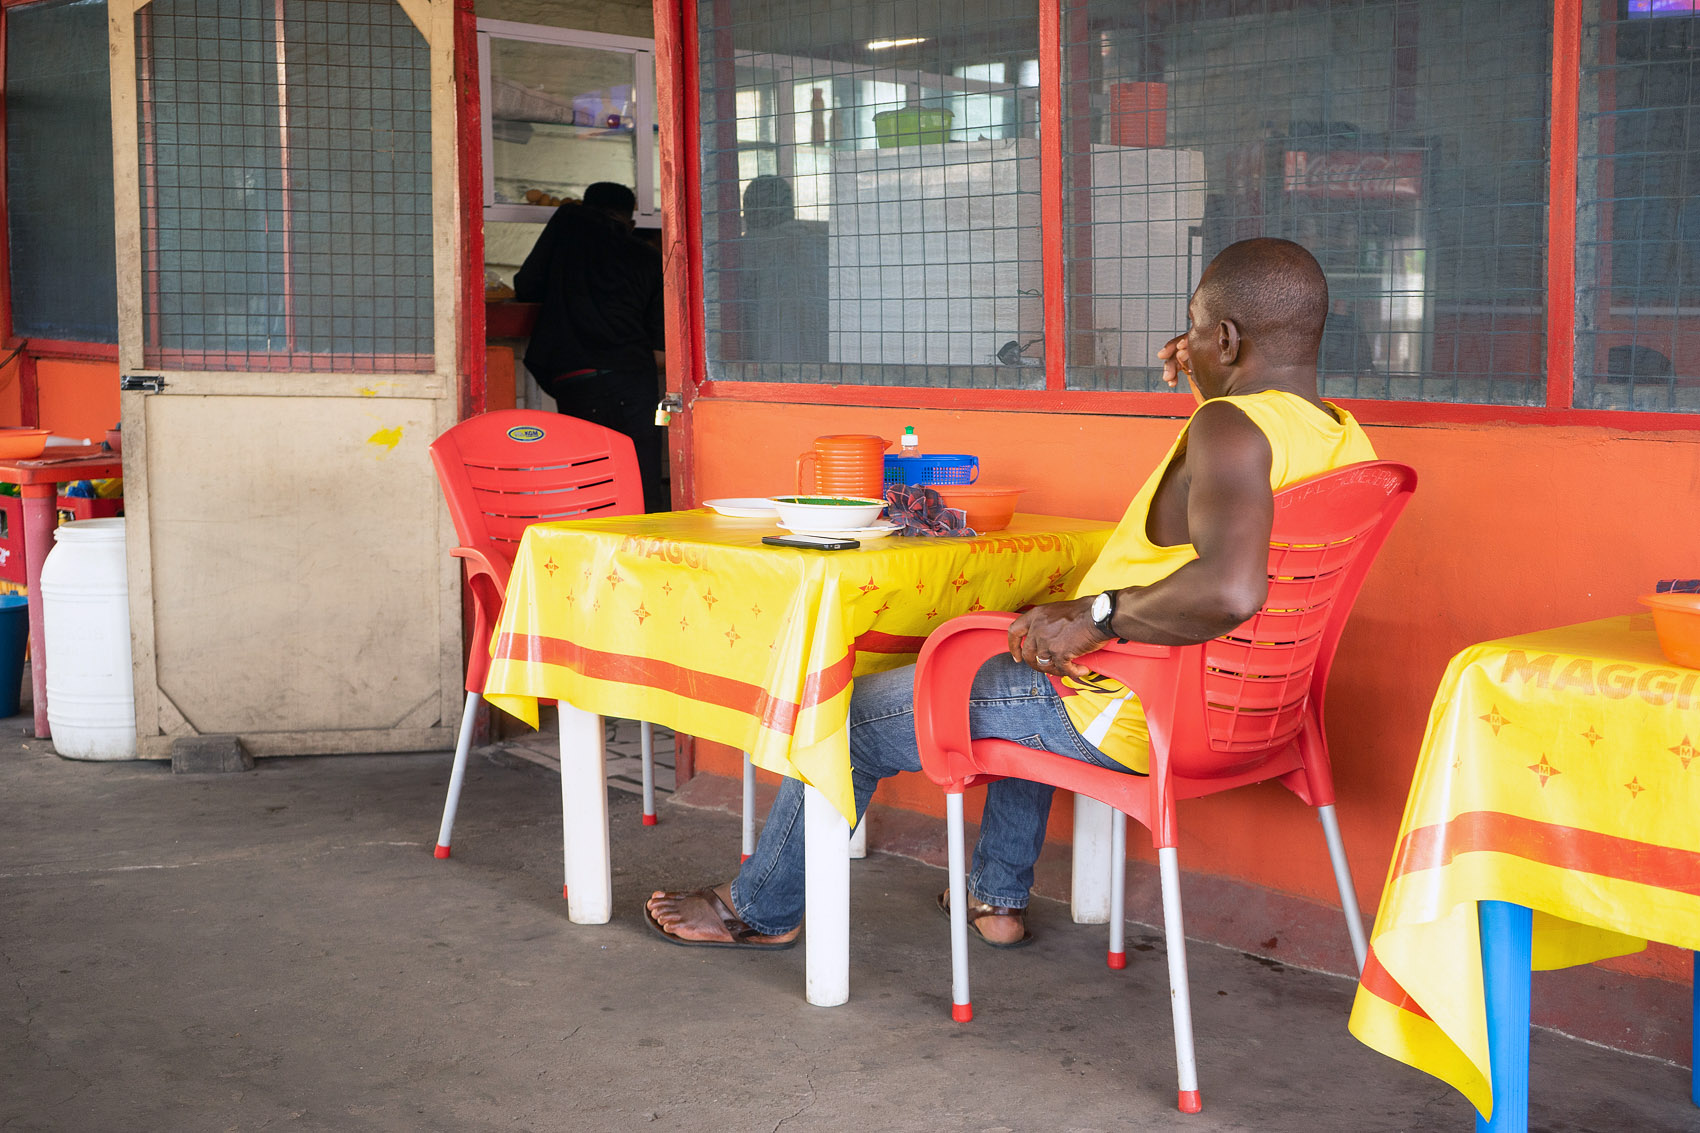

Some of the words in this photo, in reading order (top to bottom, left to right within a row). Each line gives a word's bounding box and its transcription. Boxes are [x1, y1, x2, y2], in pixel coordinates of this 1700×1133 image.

[620, 534, 712, 572] MAGGI
[968, 534, 1061, 554] MAGGI
[1501, 650, 1700, 710] MAGGI
